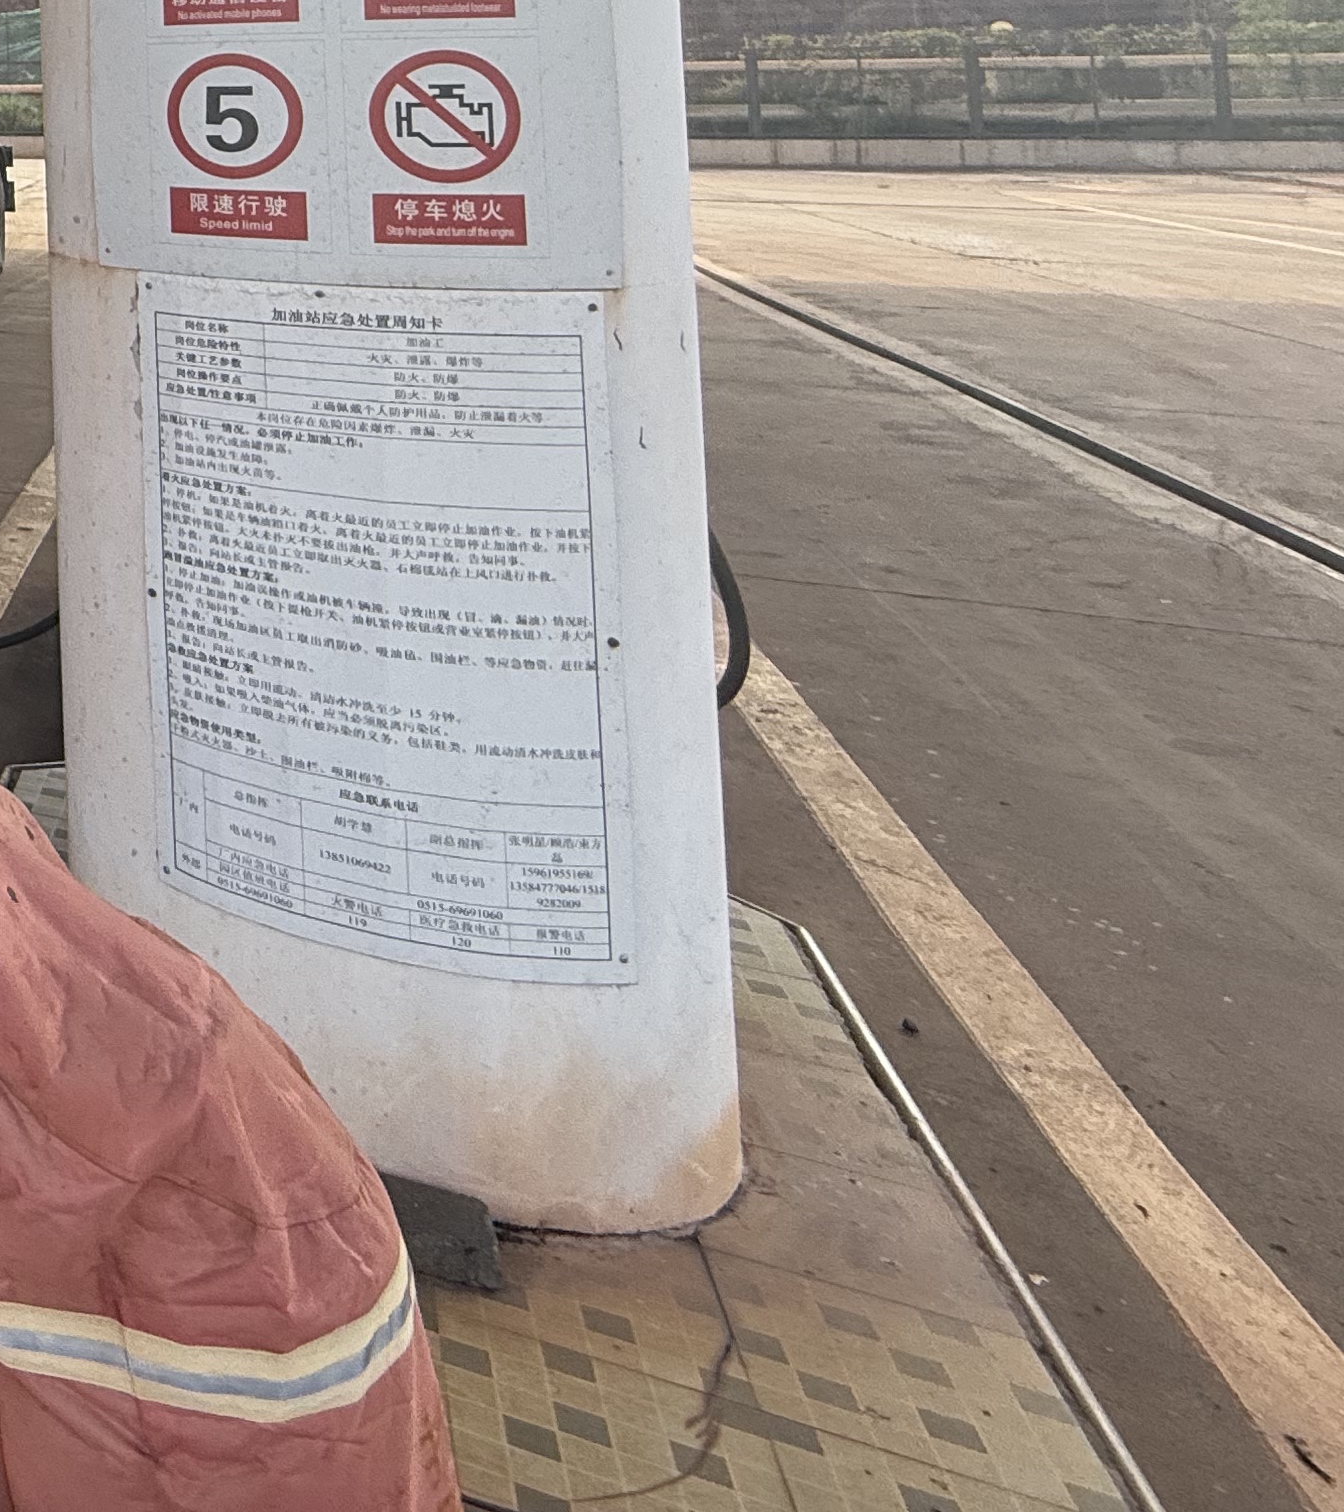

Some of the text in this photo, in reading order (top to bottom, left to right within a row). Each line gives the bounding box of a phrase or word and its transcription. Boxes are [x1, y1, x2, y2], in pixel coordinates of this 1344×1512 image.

[177, 10, 188, 20] No
[205, 85, 259, 153] 5
[189, 192, 287, 217] 限速行驶
[394, 198, 504, 222] 停车熄火
[199, 217, 239, 231] Speed
[184, 318, 229, 334] 岗位名称
[271, 307, 443, 330] 加油站应急处置周知卡
[174, 333, 240, 353] 岗位危险特性
[406, 336, 443, 348] 加油工
[175, 349, 242, 370] 关键工艺参数
[176, 366, 242, 387] 岗位操作要点
[393, 371, 458, 385] 防火、防爆
[394, 388, 460, 402] 防火、防爆
[409, 707, 422, 718] 15
[233, 788, 268, 809] 总指挥
[338, 787, 418, 813] 应急联系电话
[229, 822, 276, 847] 电话号码
[429, 832, 482, 851] 副总指挥
[218, 846, 288, 879] 厂内应急电话
[431, 869, 484, 889] 电话号码
[332, 894, 382, 918] 火警电话
[348, 915, 366, 928] 119
[419, 912, 499, 937] 医疗急救电话
[452, 935, 471, 948] 120
[536, 927, 584, 942] 报警电话
[553, 945, 570, 956] 110
